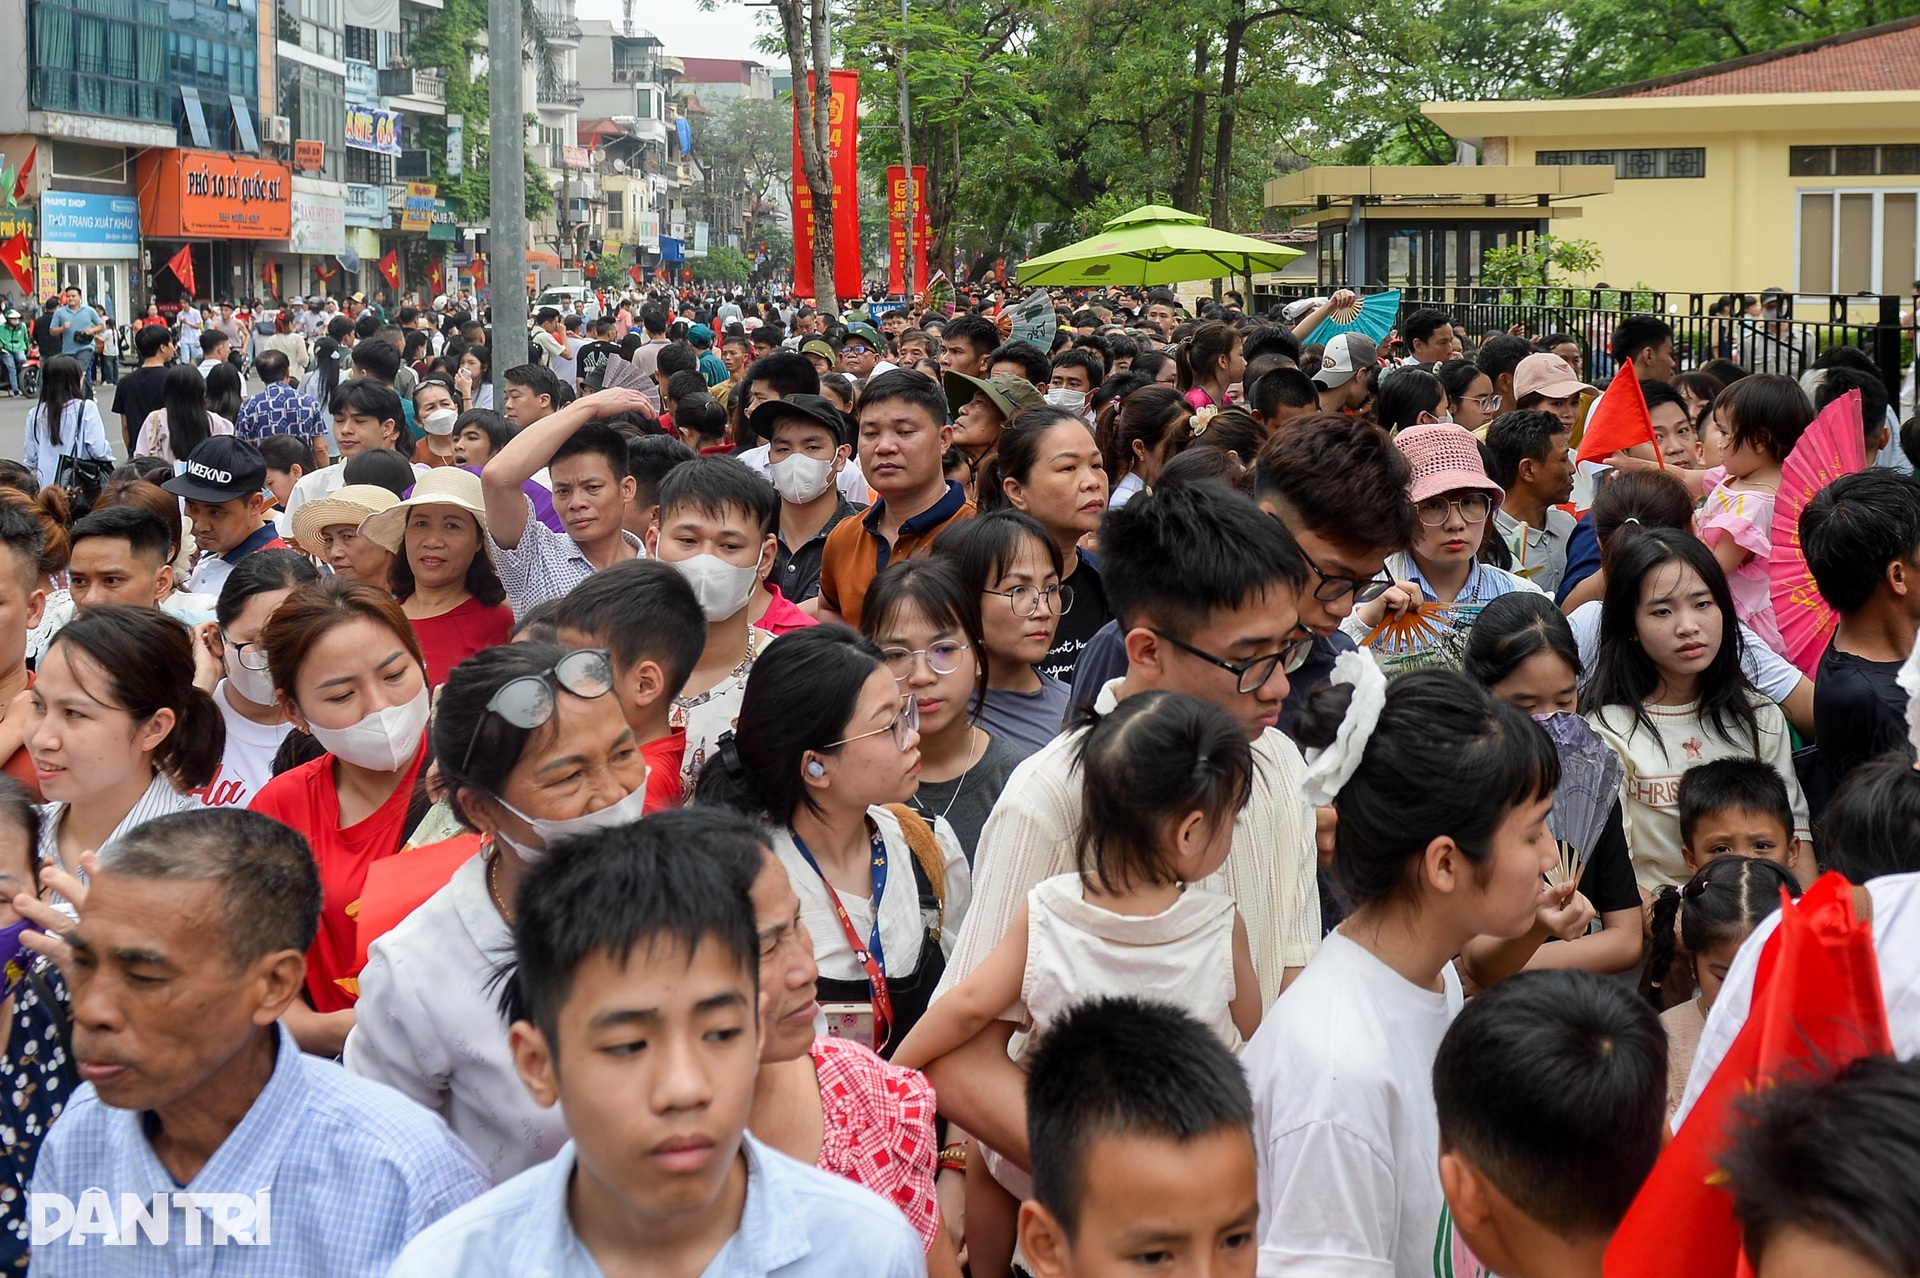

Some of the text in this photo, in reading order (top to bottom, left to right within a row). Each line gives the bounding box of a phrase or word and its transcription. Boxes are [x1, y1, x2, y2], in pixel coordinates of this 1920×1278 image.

[345, 110, 373, 143] AME
[187, 162, 281, 205] PHỞ 10 LÝ QUỐC SƯ
[68, 198, 86, 208] SHOP
[68, 214, 94, 228] TRANG
[27, 222, 33, 237] 2
[188, 460, 232, 483] WEEKND
[1046, 640, 1075, 655] ont
